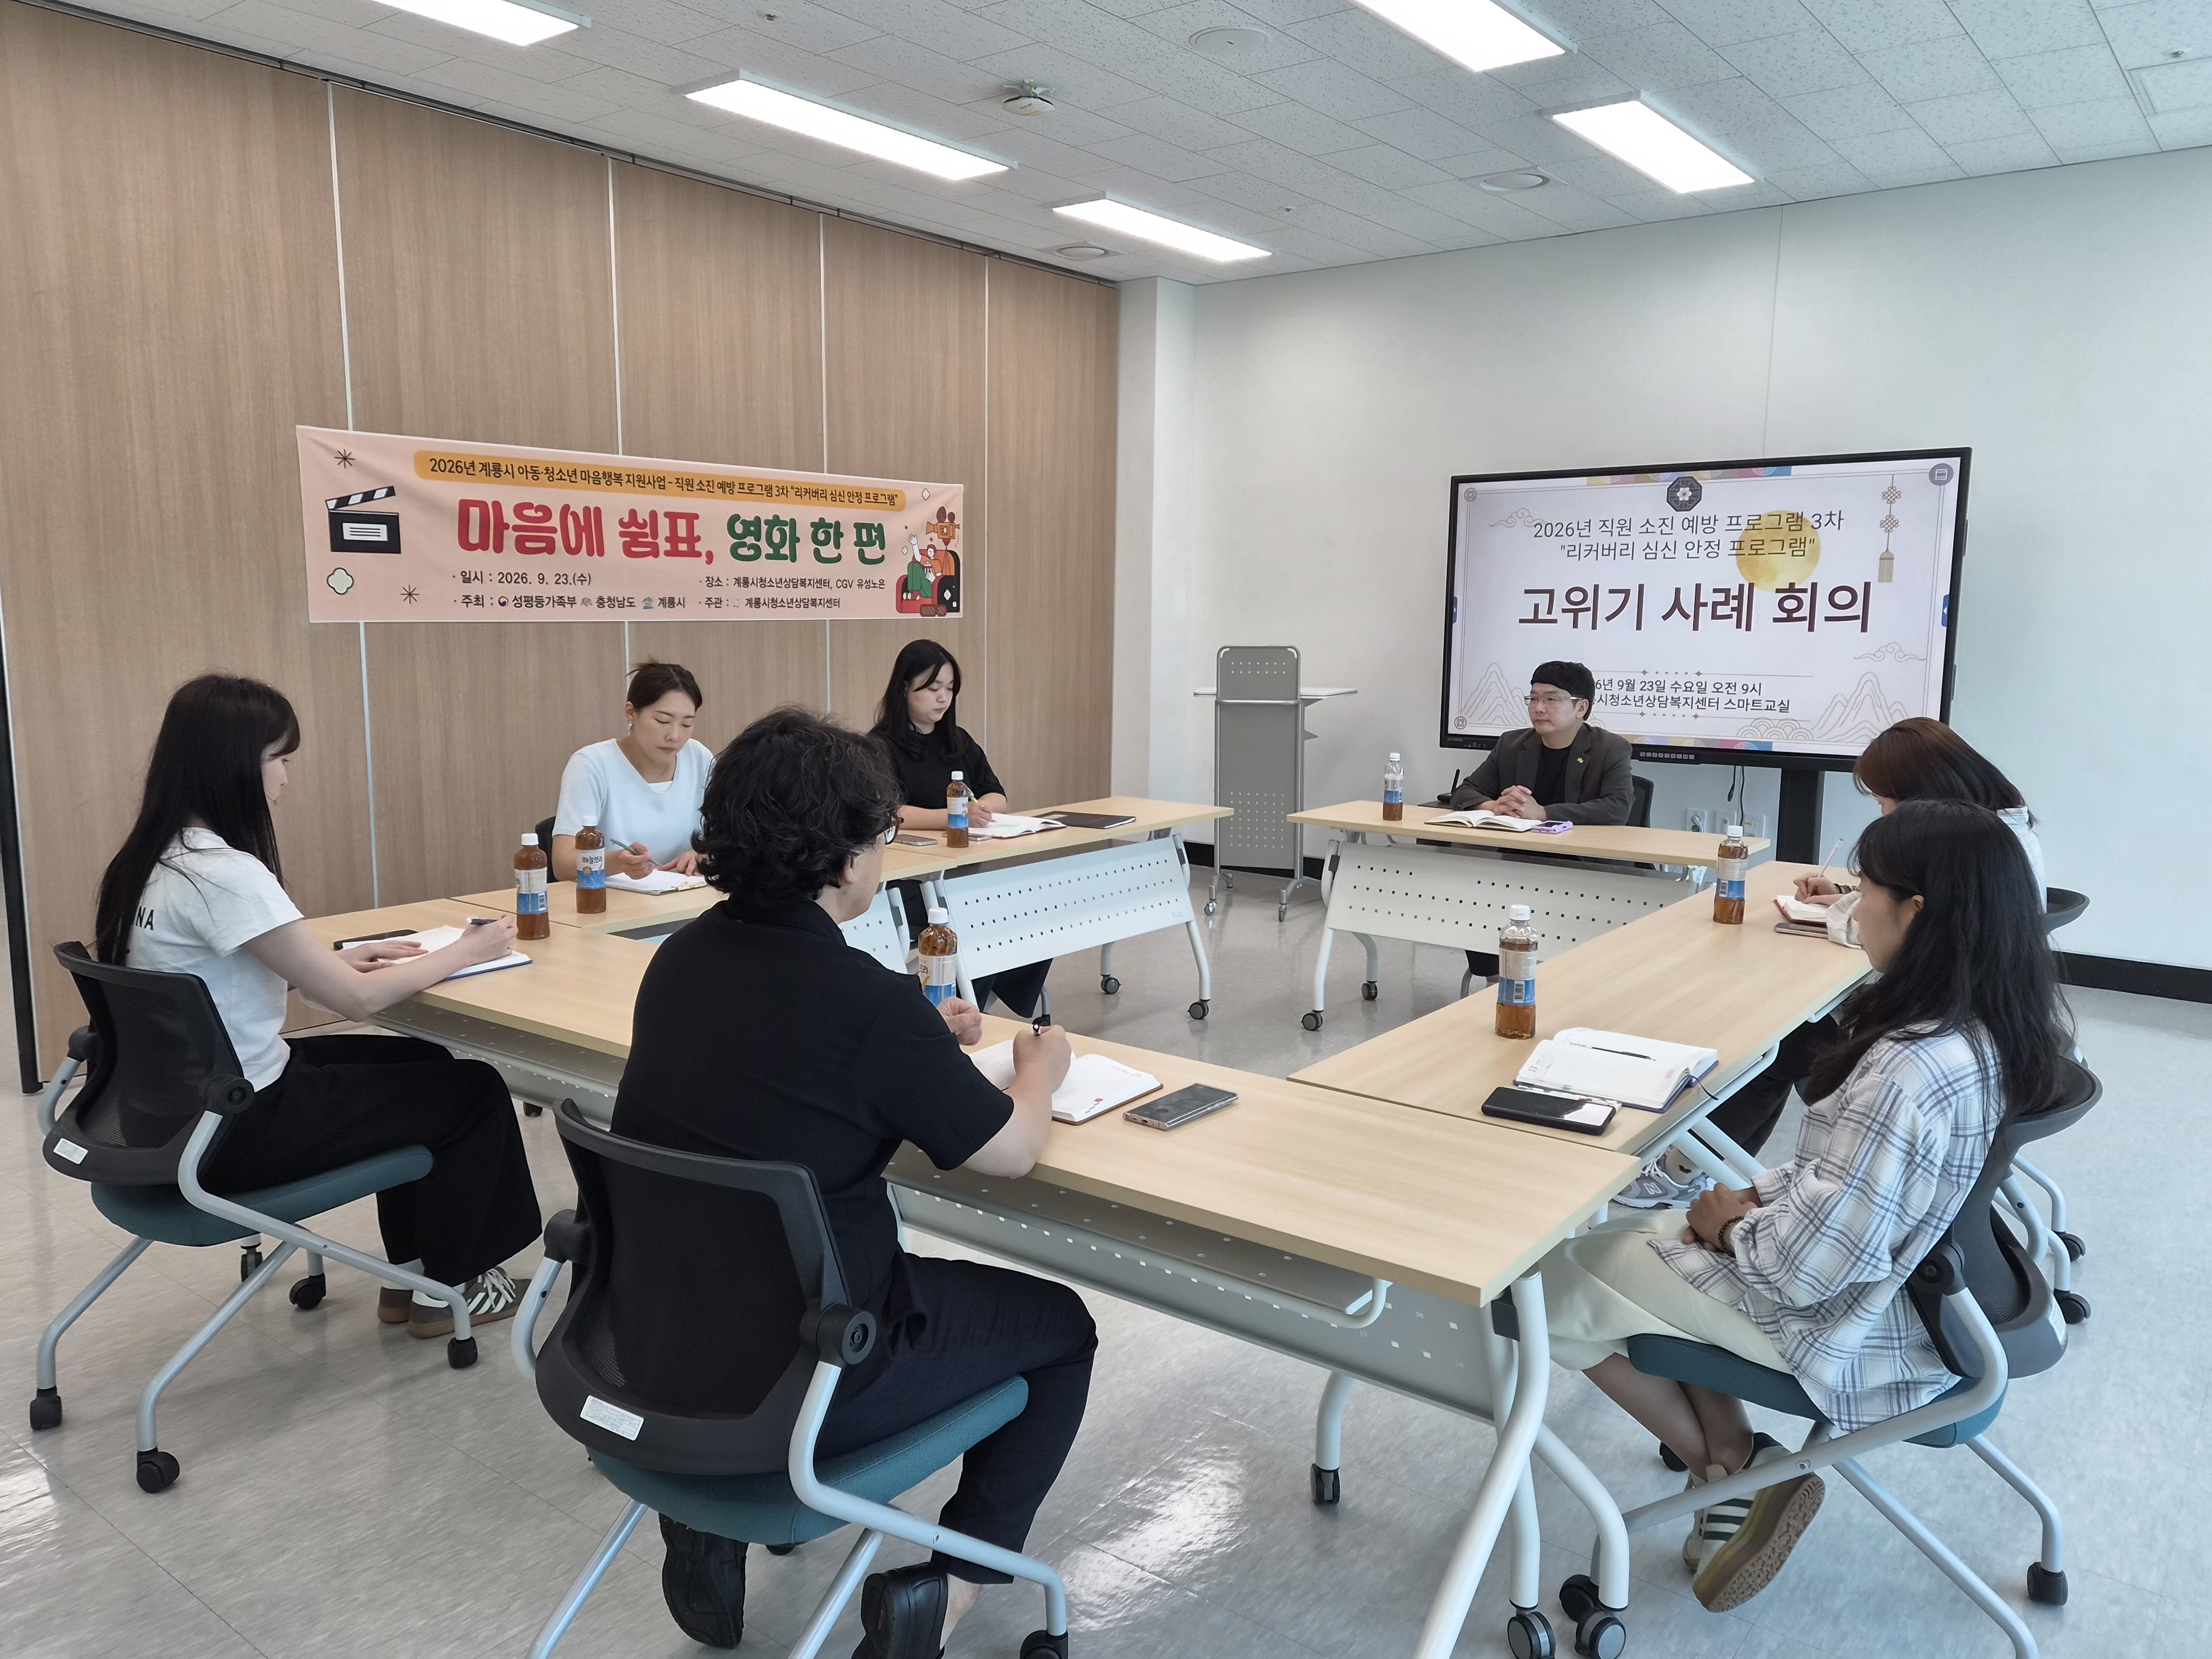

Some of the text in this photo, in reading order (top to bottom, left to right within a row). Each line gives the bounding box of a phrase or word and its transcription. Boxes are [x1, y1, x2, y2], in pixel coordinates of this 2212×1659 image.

[429, 458, 476, 477] 2026년
[478, 462, 515, 479] 계룡시
[517, 465, 577, 484] 아동·청소년
[580, 470, 623, 487] 마음행복
[625, 473, 666, 490] 지원사업
[674, 478, 693, 492] 직원
[696, 479, 715, 493] 소진
[717, 481, 735, 495] 예방
[737, 483, 773, 497] 프로그램
[775, 485, 789, 498] 3차
[830, 490, 845, 503] 심신
[847, 491, 863, 504] 안정
[457, 499, 885, 565] 마음에 쉼표, 영화 한 편
[1533, 510, 1844, 538] 2026년 직원 소진 예방 프로그램 3차
[1561, 538, 1815, 561] "리커버리 심신 안정 프로그램"
[460, 570, 484, 585] 일시
[498, 572, 532, 585] 2026.
[537, 573, 549, 585] 9.
[554, 573, 592, 587] 23.(수)
[705, 576, 723, 588] 장소
[733, 576, 833, 591] 계룡시청소년상담복지센터,
[836, 580, 854, 589] CGV
[856, 579, 885, 590] 유성노은
[461, 594, 484, 608] 주최
[512, 595, 577, 609] 성평등가족부
[595, 596, 636, 609] 충청남도
[658, 596, 686, 608] 계룡시
[705, 597, 722, 608] 주관
[745, 597, 840, 609] 계룡시청소년상담복지센터
[1518, 581, 1872, 633] 고위기 사례 회의
[1617, 679, 1635, 691] 9월
[1640, 680, 1666, 693] 23일
[1670, 680, 1707, 694] 수요일
[1712, 681, 1737, 695] 오전
[1741, 682, 1762, 696] 9시
[1724, 698, 1790, 713] 스마트교실
[135, 905, 154, 931] NA
